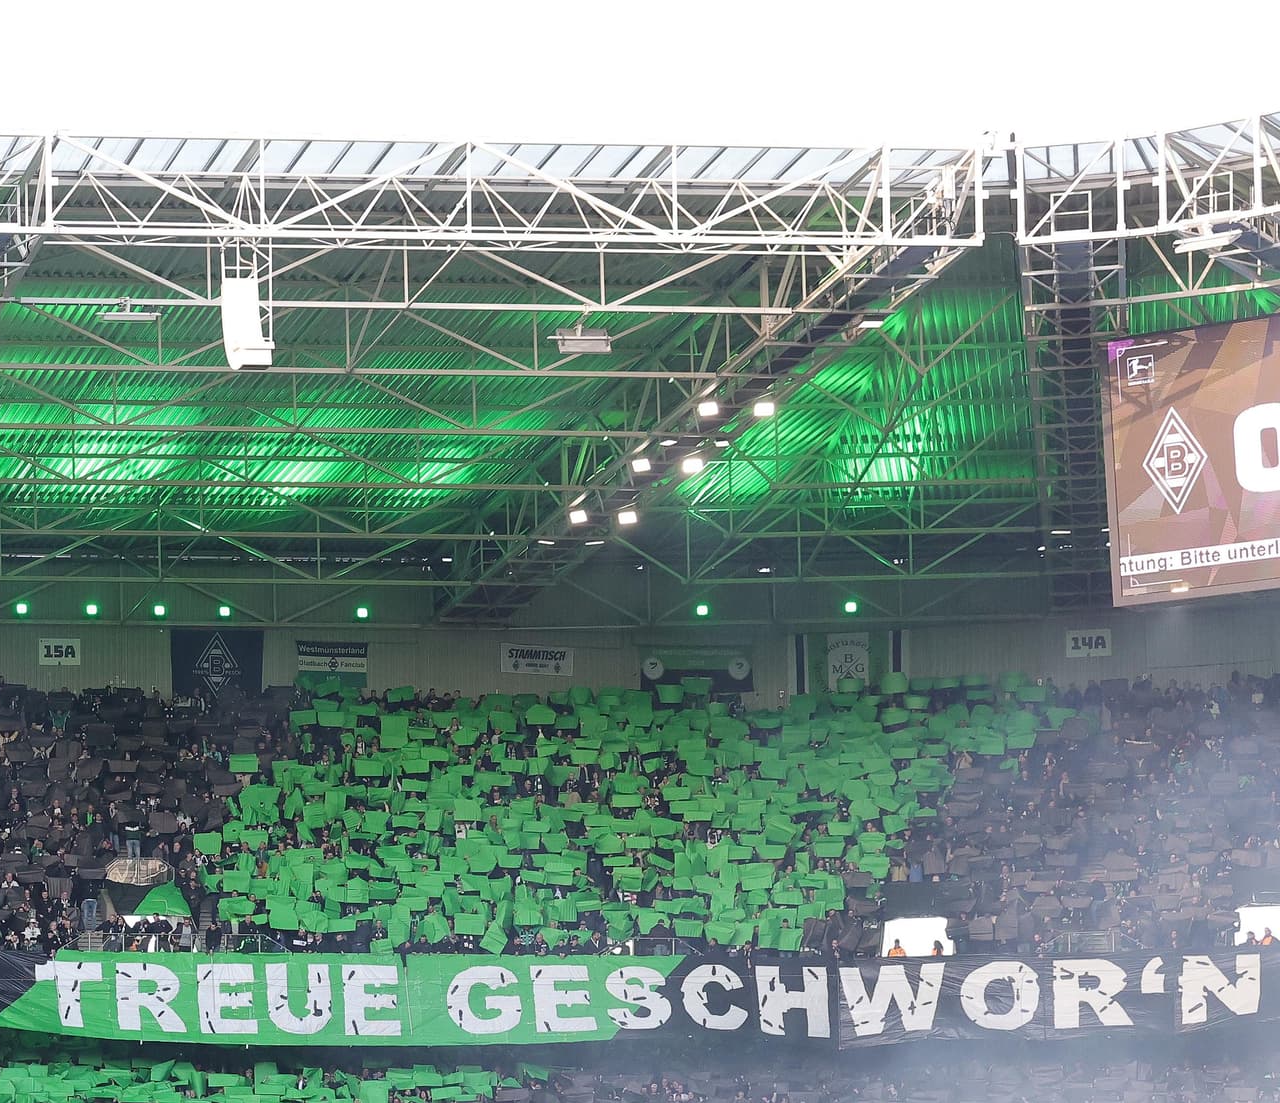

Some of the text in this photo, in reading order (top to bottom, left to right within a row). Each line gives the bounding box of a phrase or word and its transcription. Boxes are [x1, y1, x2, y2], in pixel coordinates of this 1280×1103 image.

[1181, 551, 1221, 566] Bitte
[1071, 636, 1107, 650] 14A
[44, 645, 76, 659] 15A
[508, 648, 567, 662] STAMMTISCH
[35, 960, 403, 1036] TREUE
